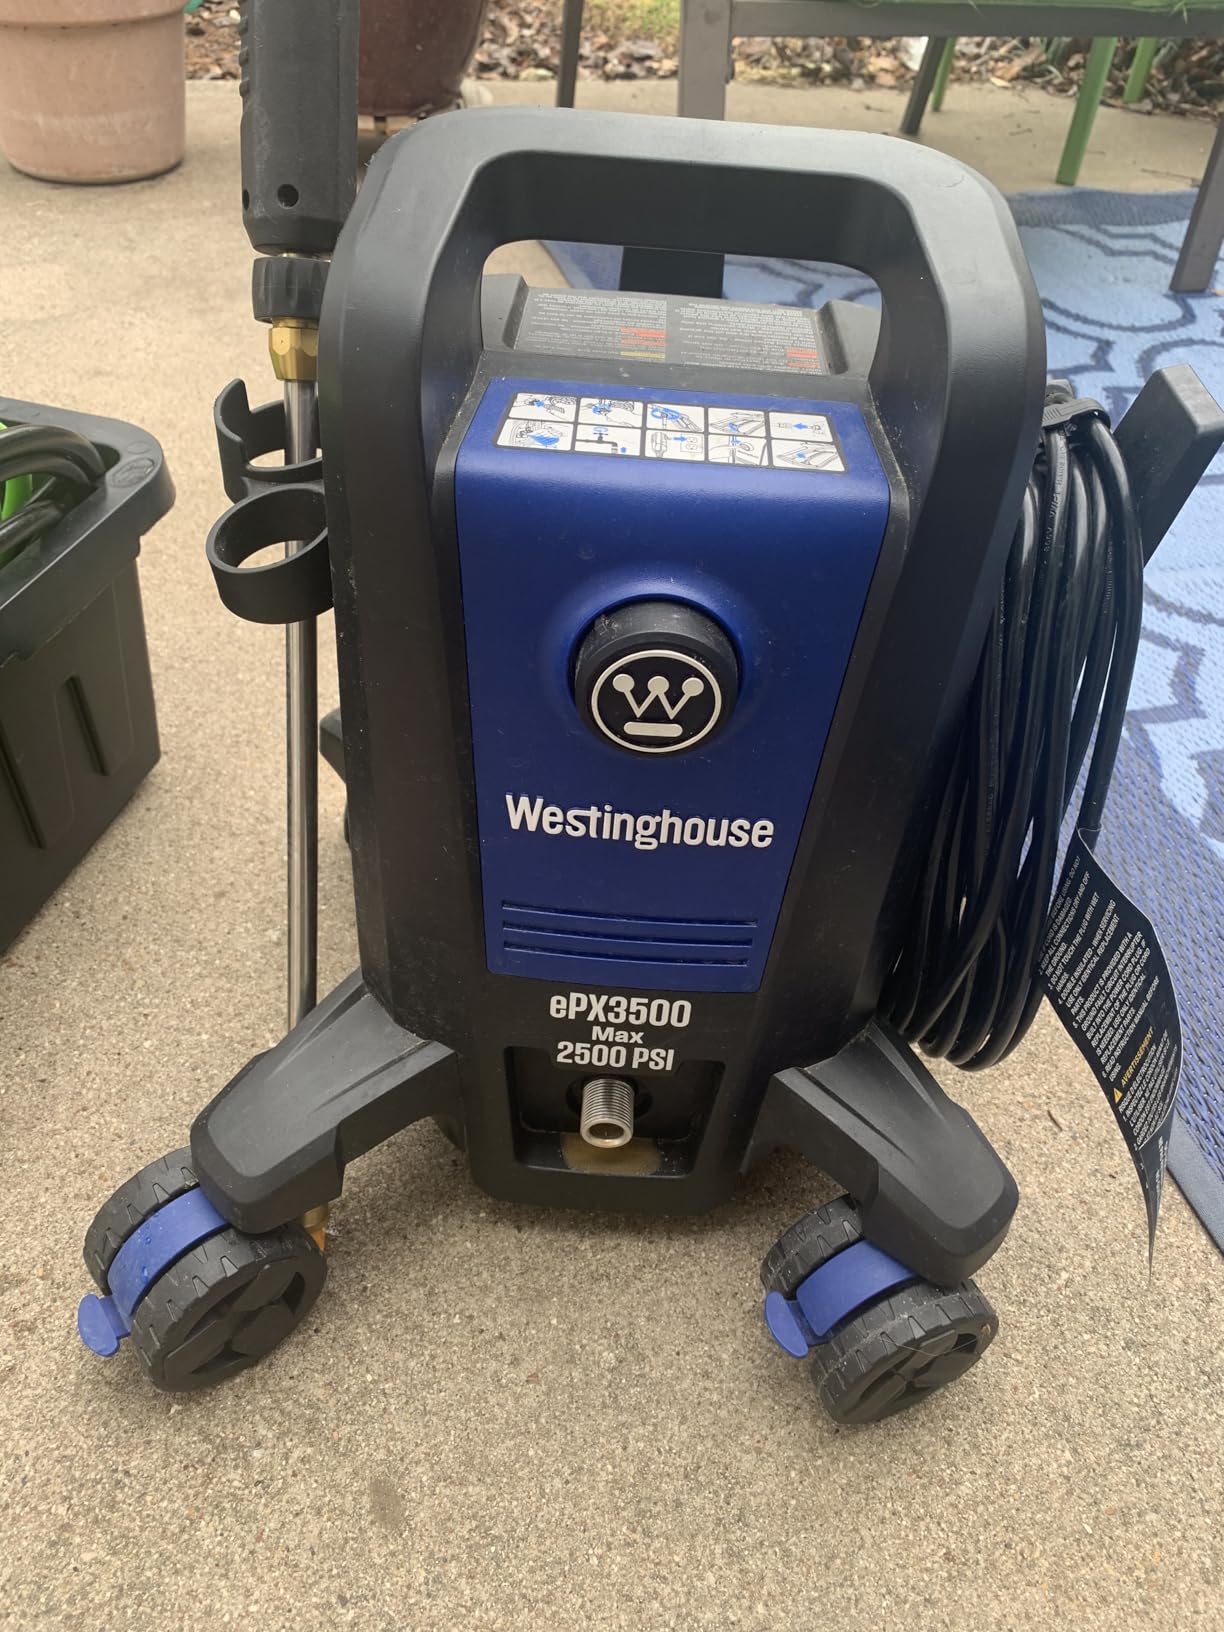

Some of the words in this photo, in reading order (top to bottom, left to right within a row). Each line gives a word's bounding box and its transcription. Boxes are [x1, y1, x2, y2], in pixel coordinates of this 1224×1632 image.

[505, 793, 774, 850] Westinghouse
[1041, 954, 1050, 970] KEEP
[1048, 944, 1056, 956] ALL
[1054, 907, 1076, 946] CONNECTIONS
[1083, 871, 1091, 885] OFF
[1056, 962, 1064, 977] NOT
[1063, 944, 1075, 965] TOUCH
[1074, 934, 1082, 946] THE
[1080, 919, 1088, 936] PLUG
[1086, 905, 1094, 921] WITH
[1062, 977, 1075, 1000] DOUBLE
[1075, 948, 1093, 979] INSULATED
[1093, 928, 1103, 947] WHEN
[1101, 899, 1115, 931] SERVICING
[1074, 980, 1082, 996] ONLY
[1082, 953, 1098, 983] IDENTICAL
[1098, 913, 1119, 956] REPLACEMENT
[1046, 964, 1054, 977] THE
[1078, 1009, 1086, 1023] THIS
[1084, 984, 1101, 1011] PRODUCT
[1103, 951, 1121, 981] PROVIDED
[1120, 936, 1130, 953] WITH
[1082, 1007, 1097, 1032] GROUND
[1096, 990, 1108, 1009] FAULT
[1106, 968, 1120, 993] CIRCUIT
[1118, 931, 1142, 972] INTERRUPTER
[1087, 1022, 1098, 1040] BUILT
[1096, 1009, 1105, 1025] INTO
[1104, 998, 1112, 1012] THE
[1110, 979, 1124, 1002] POWER
[1122, 962, 1134, 982] CORD
[1092, 1008, 1116, 1048] REPLACEMENT
[1120, 988, 1128, 1002] THE
[1126, 974, 1137, 991] PLUG
[1140, 948, 1151, 967] CORD
[1113, 1014, 1122, 1028] USE
[1120, 1000, 1131, 1017] ONLY
[1128, 973, 1146, 1003] IDENTICAL
[549, 992, 692, 1028] ePX3500
[591, 1025, 644, 1044] Max
[1101, 1024, 1125, 1065] REPLACEMENT
[1106, 1056, 1116, 1073] READ
[1114, 1022, 1136, 1059] INSTRUCTION
[1134, 1000, 1148, 1024] MANUAL
[1146, 976, 1160, 1001] BEFORE
[556, 1041, 627, 1068] 2500
[632, 1047, 674, 1071] PSI
[1122, 1026, 1154, 1088] AVERTISSEMENT
